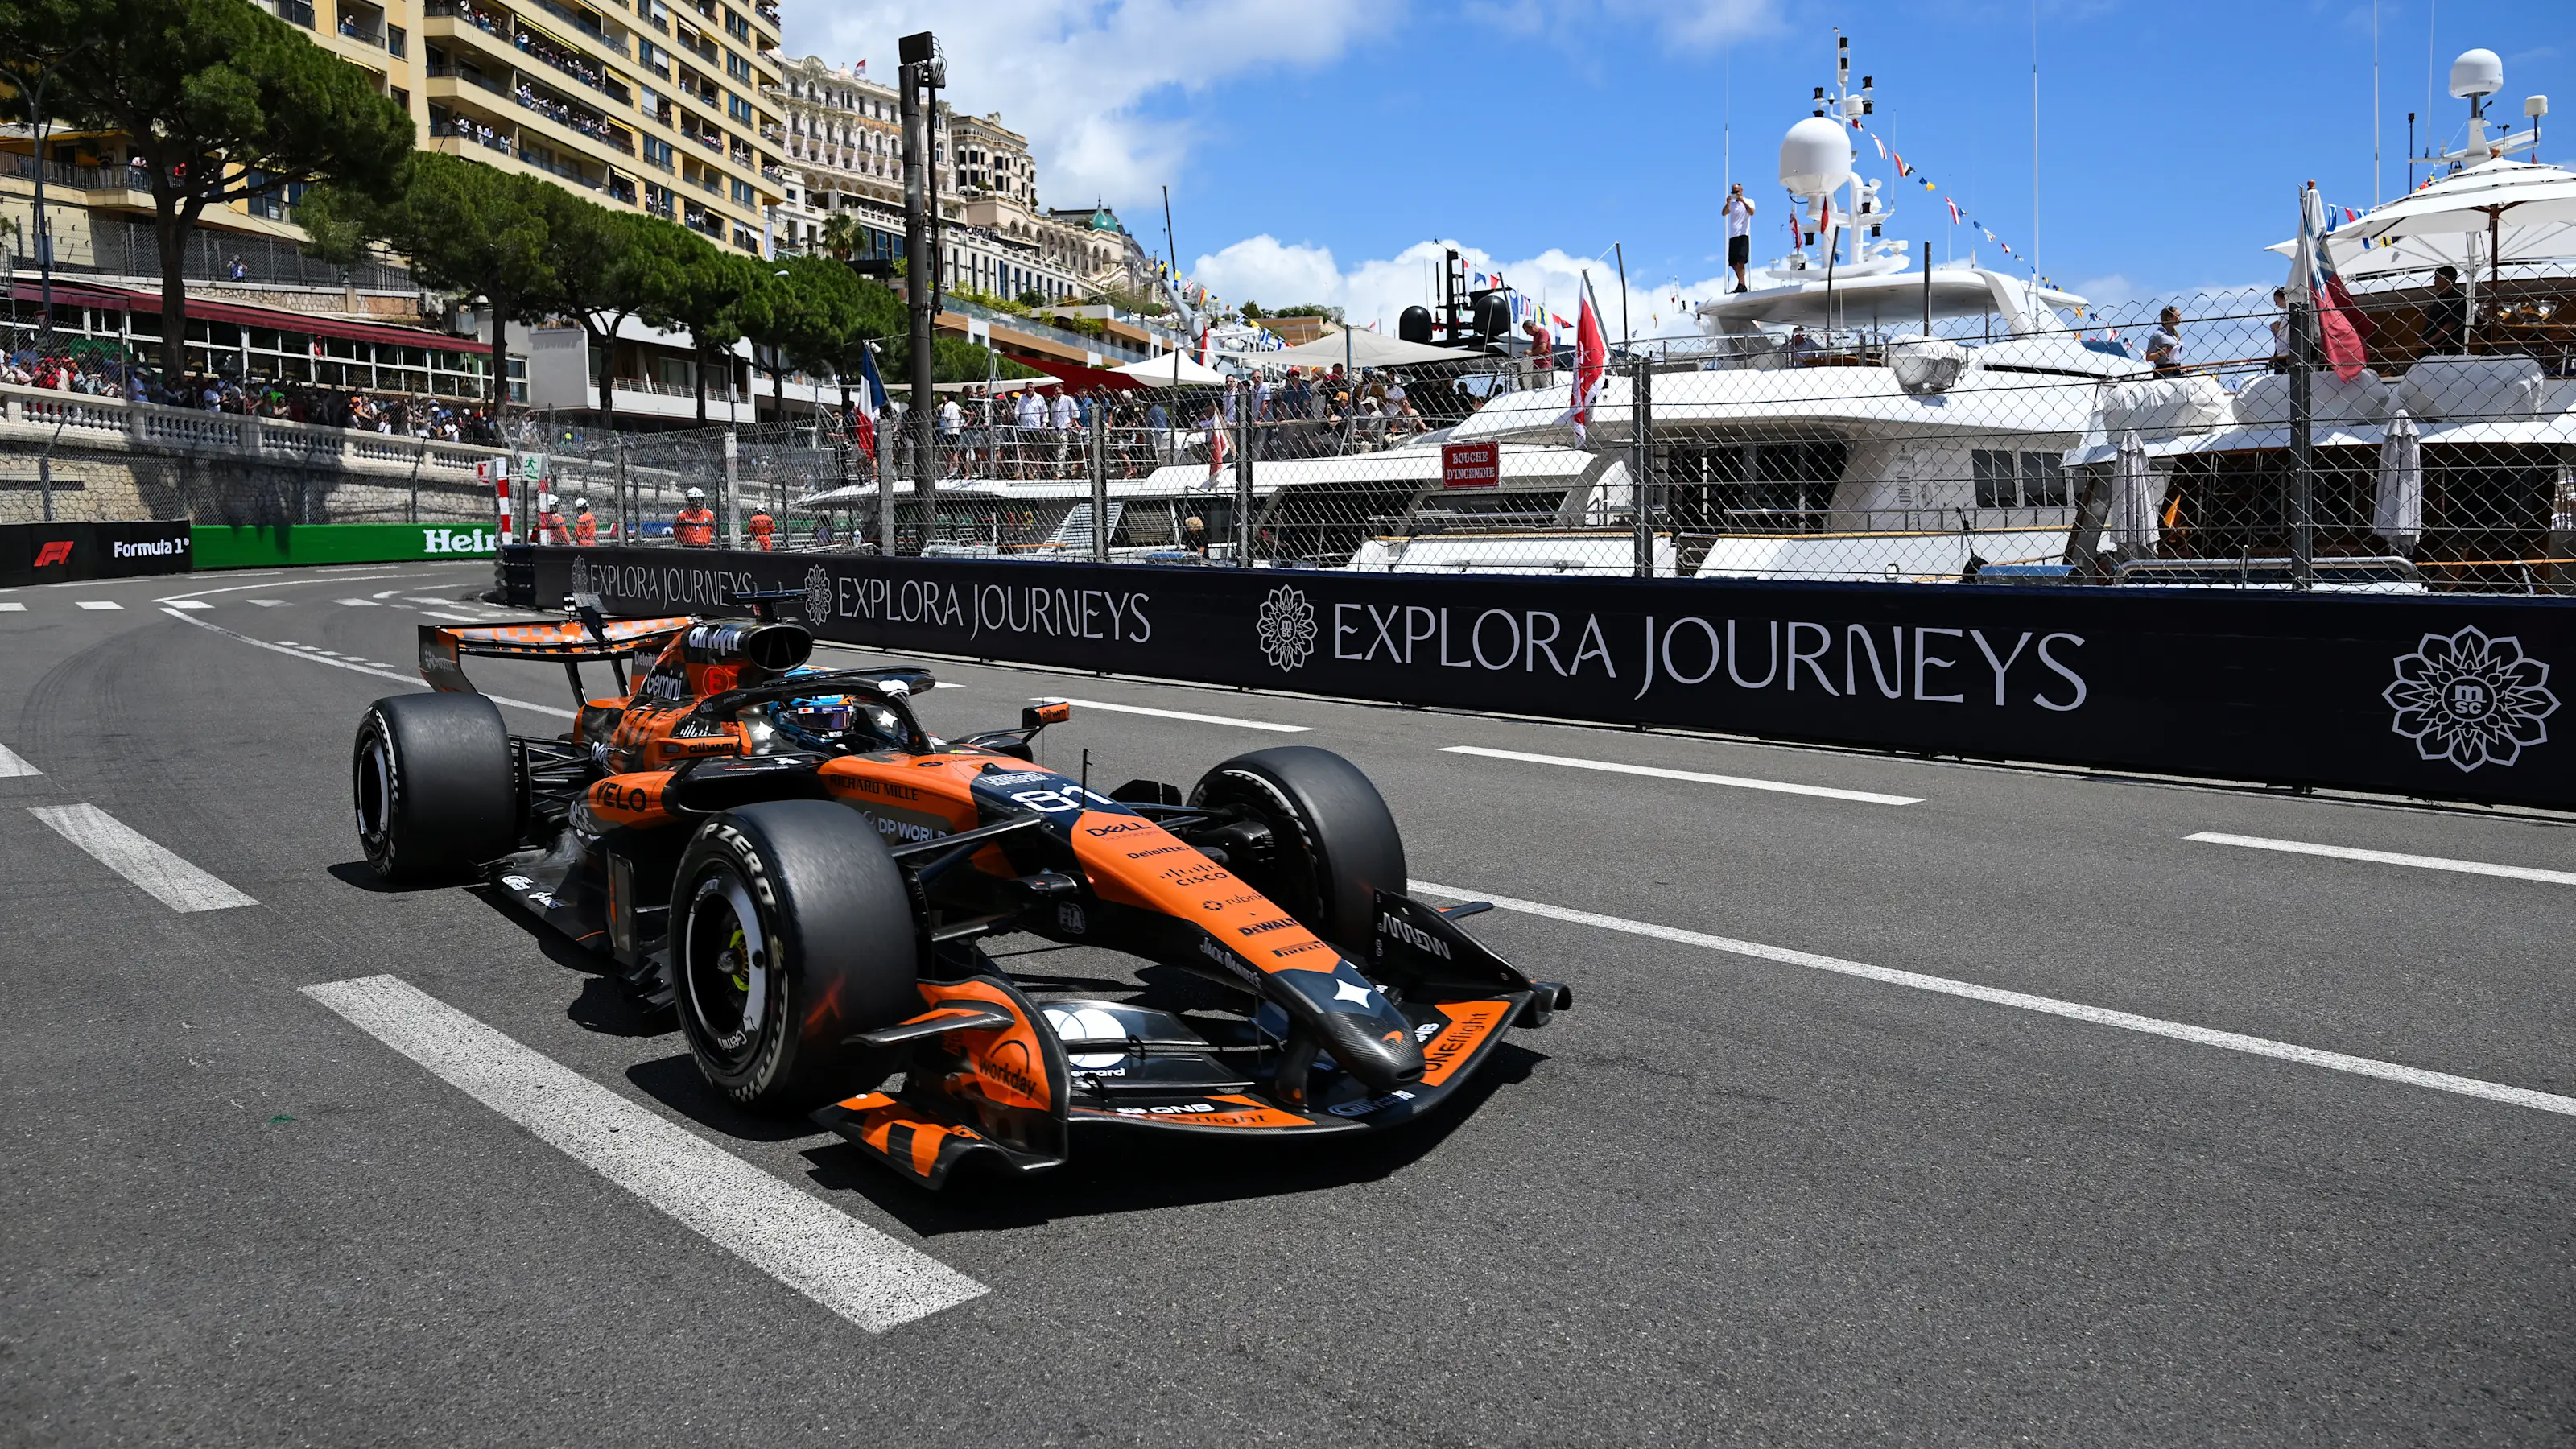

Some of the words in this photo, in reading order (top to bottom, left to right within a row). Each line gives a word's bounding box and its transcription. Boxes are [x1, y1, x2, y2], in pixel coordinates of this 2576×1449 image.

[1452, 451, 1488, 464] BOUCHE
[1447, 466, 1495, 481] D'INCENDIE
[114, 539, 172, 558] Formula
[590, 564, 659, 600] EXPLORA
[663, 568, 755, 610] JOURNEYS
[839, 577, 964, 626] EXPLORA
[970, 584, 1151, 643] JOURNEYS
[689, 627, 741, 656] allwyn
[1335, 603, 1617, 679] EXPLORA
[1634, 616, 2087, 712] JOURNEYS
[646, 665, 683, 701] Gemini
[688, 742, 734, 753] allwyn
[829, 774, 880, 795] RICHARD
[882, 783, 919, 801] MILLE
[988, 772, 1037, 783] Hilton
[597, 781, 646, 812] VELO
[1010, 786, 1114, 813] 81
[878, 817, 897, 835] DP
[1085, 822, 1152, 837] DELL
[701, 822, 720, 840] P
[716, 824, 777, 906] ZERO
[979, 1058, 1037, 1100] workday
[1150, 1104, 1216, 1114] QNB
